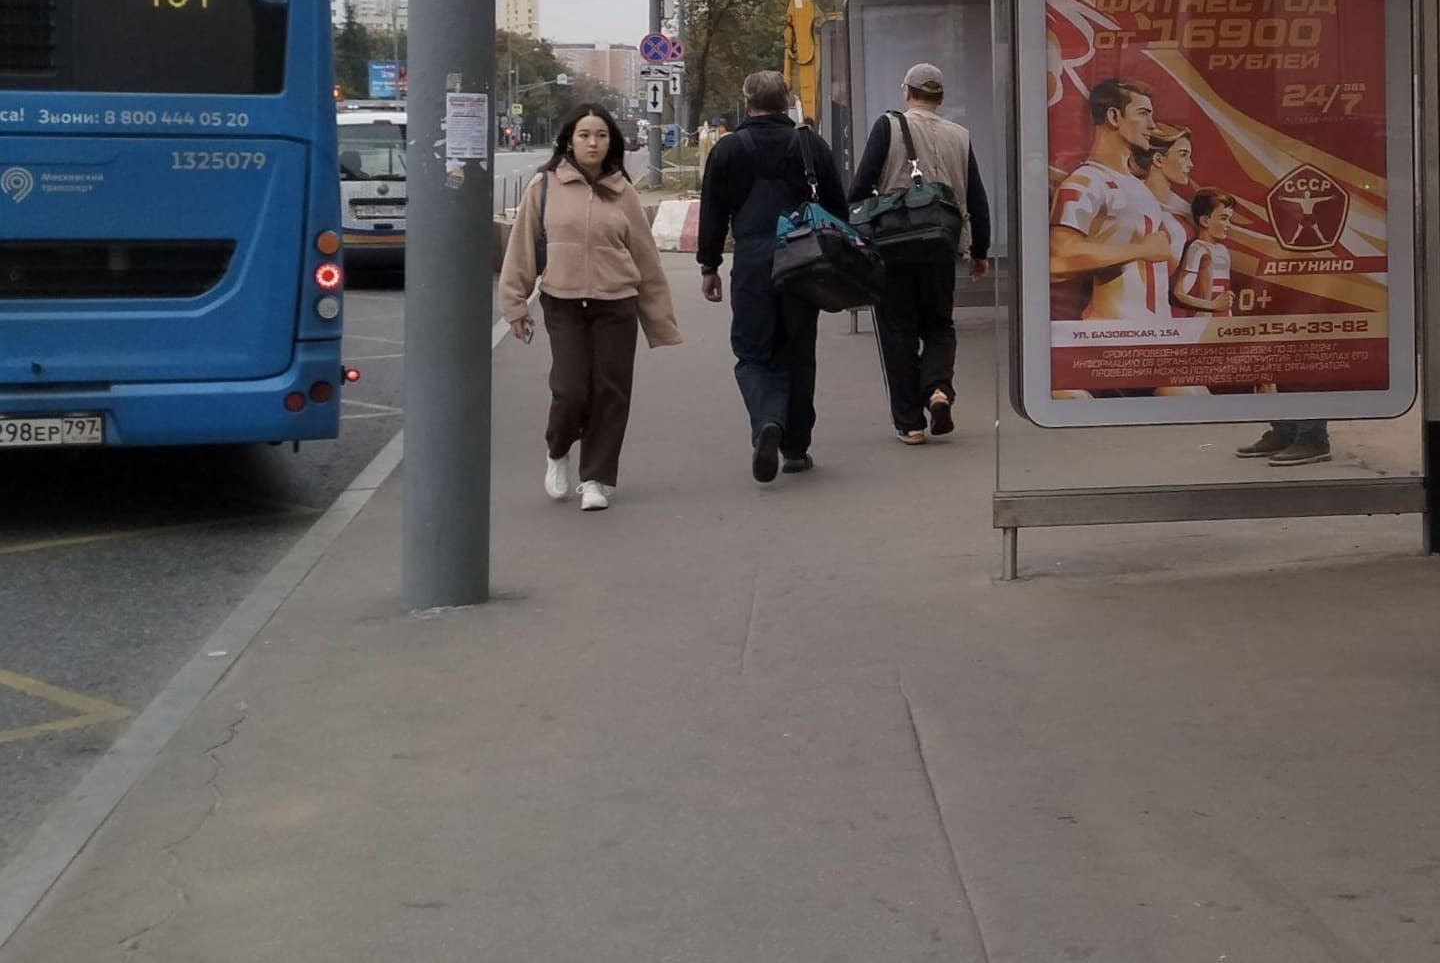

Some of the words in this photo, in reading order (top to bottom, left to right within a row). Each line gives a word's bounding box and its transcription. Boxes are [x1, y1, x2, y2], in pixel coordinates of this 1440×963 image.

[1094, 31, 1137, 49] ОТ
[1148, 18, 1322, 49] 16900
[1208, 50, 1321, 70] РУБЛЕЙ
[39, 108, 100, 124] Звони:
[104, 110, 116, 125] 8
[120, 110, 156, 125] 800
[161, 111, 195, 126] 444
[200, 112, 223, 127] 05
[227, 112, 249, 127] 20
[171, 151, 267, 170] 1325079
[1284, 178, 1331, 192] СССР
[1264, 259, 1354, 275] ДЕГУНИНО
[1238, 288, 1272, 311] 0+
[1073, 331, 1088, 340] УЛ.
[1160, 329, 1180, 337] 15А
[1217, 327, 1256, 337] (495)
[1259, 320, 1369, 335] 154-33-82
[0, 422, 60, 442] 98ЕР
[64, 419, 97, 435] 797
